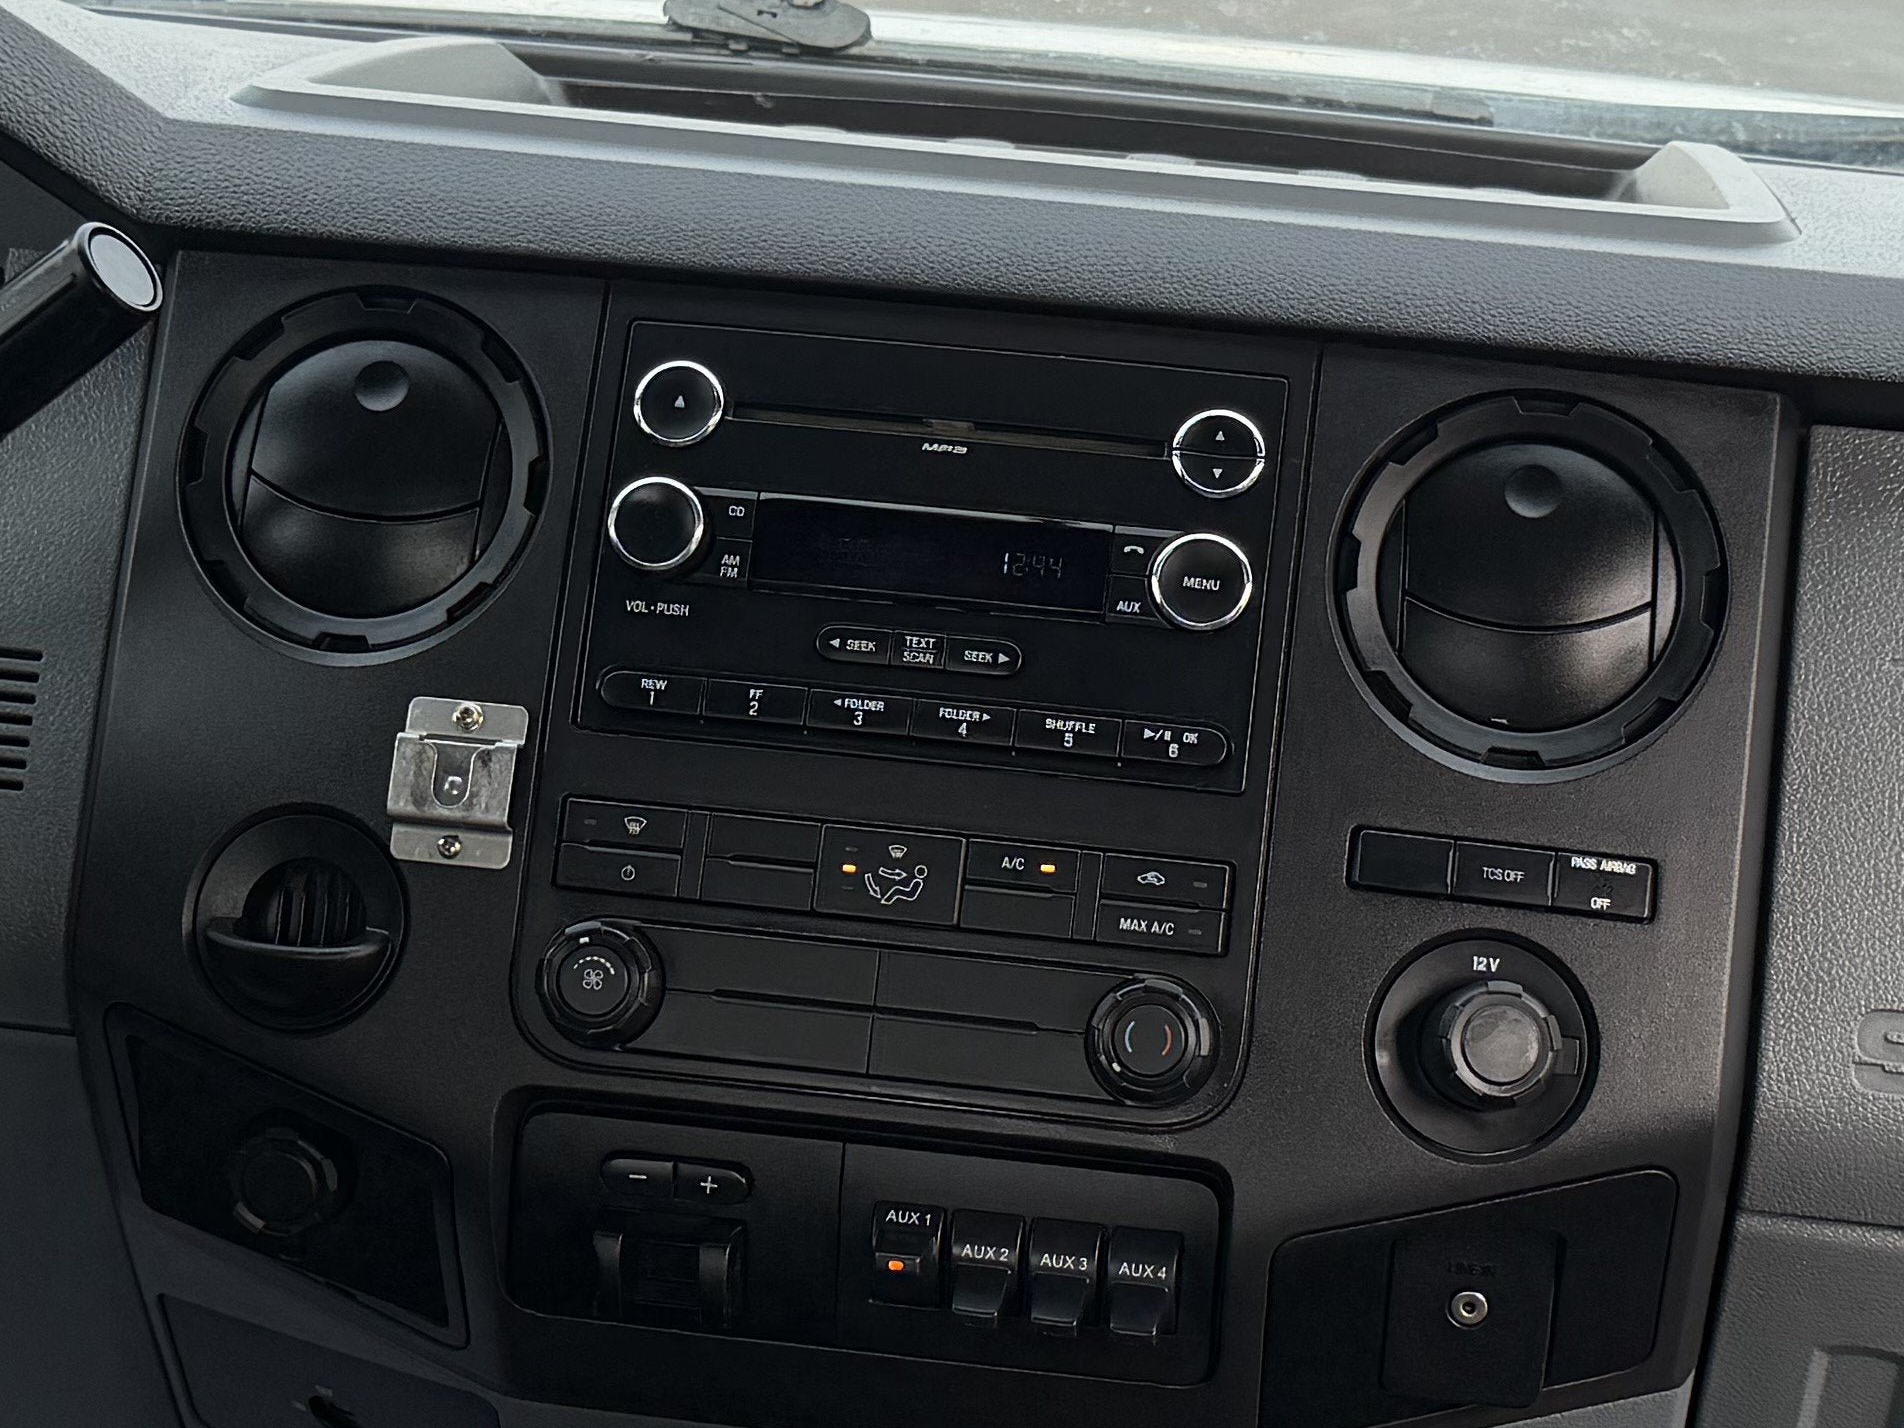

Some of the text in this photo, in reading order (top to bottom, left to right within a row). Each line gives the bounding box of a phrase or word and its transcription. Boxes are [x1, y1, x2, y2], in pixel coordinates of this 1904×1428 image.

[728, 505, 745, 518] CD
[721, 554, 741, 567] AM
[1002, 552, 1065, 579] 12:44
[719, 566, 739, 578] FM
[1182, 576, 1221, 591] MENU
[1116, 600, 1142, 614] AUX
[845, 639, 877, 653] SEEK
[904, 636, 937, 649] TEXT
[901, 651, 934, 665] SCAN
[963, 649, 994, 664] SEEK
[641, 678, 668, 691] REW
[649, 690, 655, 706] 1
[749, 688, 764, 700] FF
[748, 702, 759, 716] 2
[844, 698, 885, 712] FOLDER
[853, 711, 863, 726] 3
[938, 706, 981, 721] FOLDER
[957, 723, 968, 738] 4
[1044, 717, 1096, 734] SHUFFLE
[1063, 733, 1074, 747] 5
[1168, 743, 1179, 758] 6
[1001, 856, 1026, 871] A/C
[1570, 855, 1637, 876] PASS AIRBAG
[1482, 866, 1526, 883] TCS OFF
[1590, 897, 1612, 911] OFF
[1118, 917, 1176, 936] MAX A/C
[885, 1209, 932, 1226] AUX 1
[961, 1243, 1010, 1262] AUX 2
[1040, 1252, 1088, 1271] AUX 3
[1118, 1261, 1168, 1280] AUX 4
